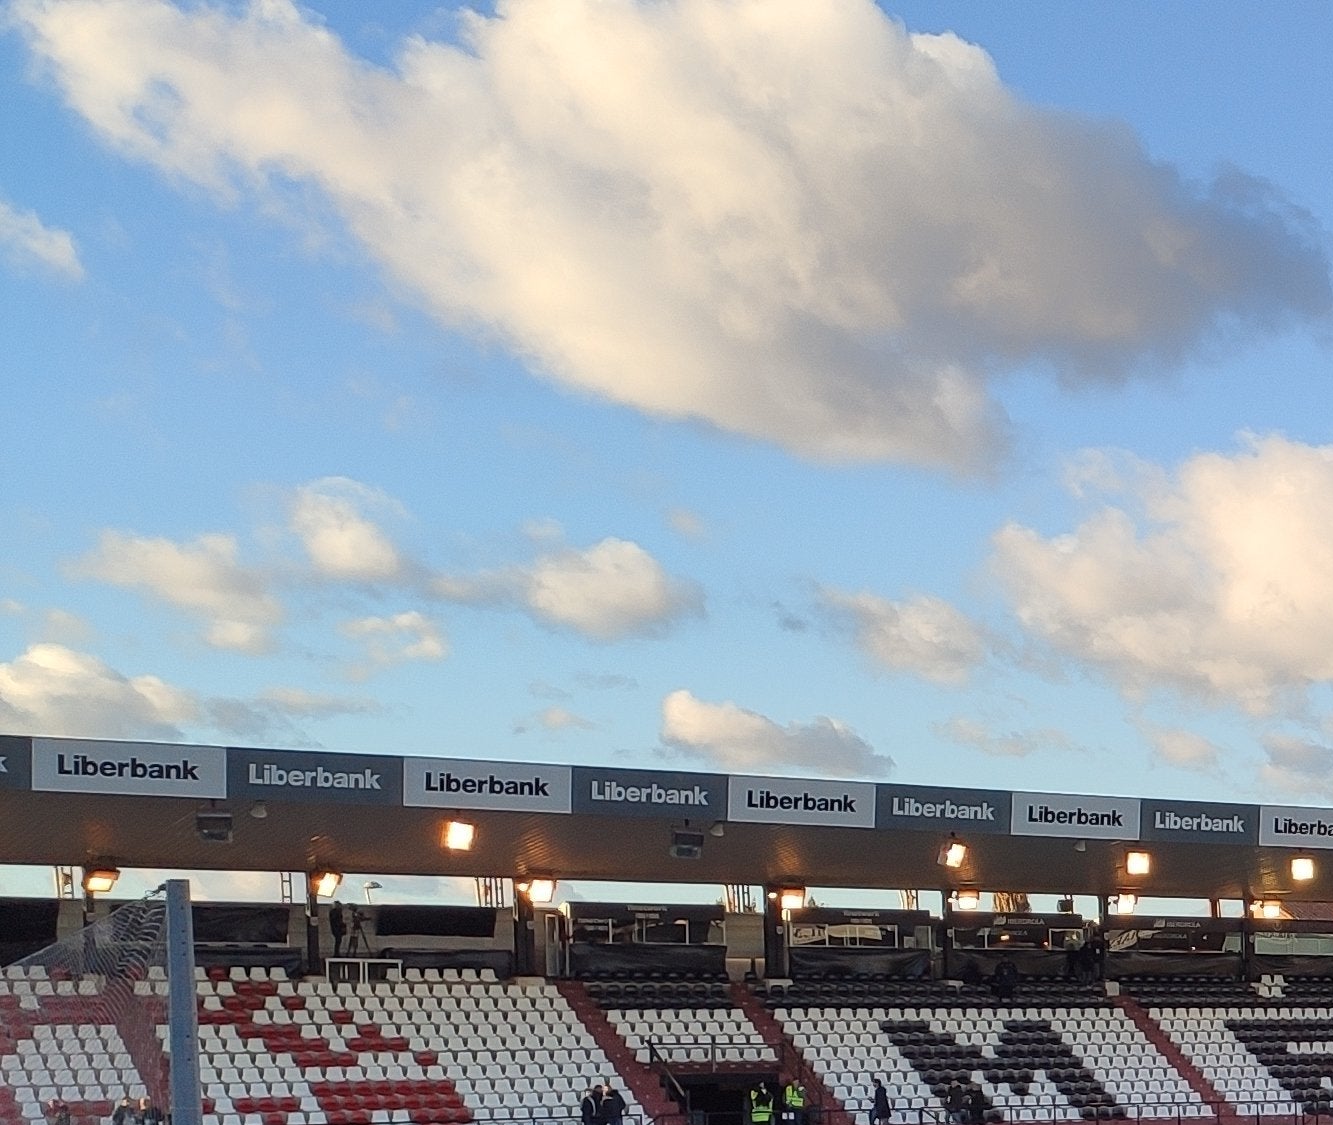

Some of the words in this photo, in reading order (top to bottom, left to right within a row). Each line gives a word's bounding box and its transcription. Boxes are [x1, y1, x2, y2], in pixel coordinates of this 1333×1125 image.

[58, 753, 200, 781] Liberbank
[248, 763, 382, 791] Liberbank
[425, 770, 550, 798] Liberbank
[590, 780, 708, 807] Liberbank
[747, 789, 857, 814] Liberbank
[892, 797, 995, 822] Liberbank
[1027, 805, 1123, 828] Liberbank
[1154, 812, 1245, 833] Liberbank
